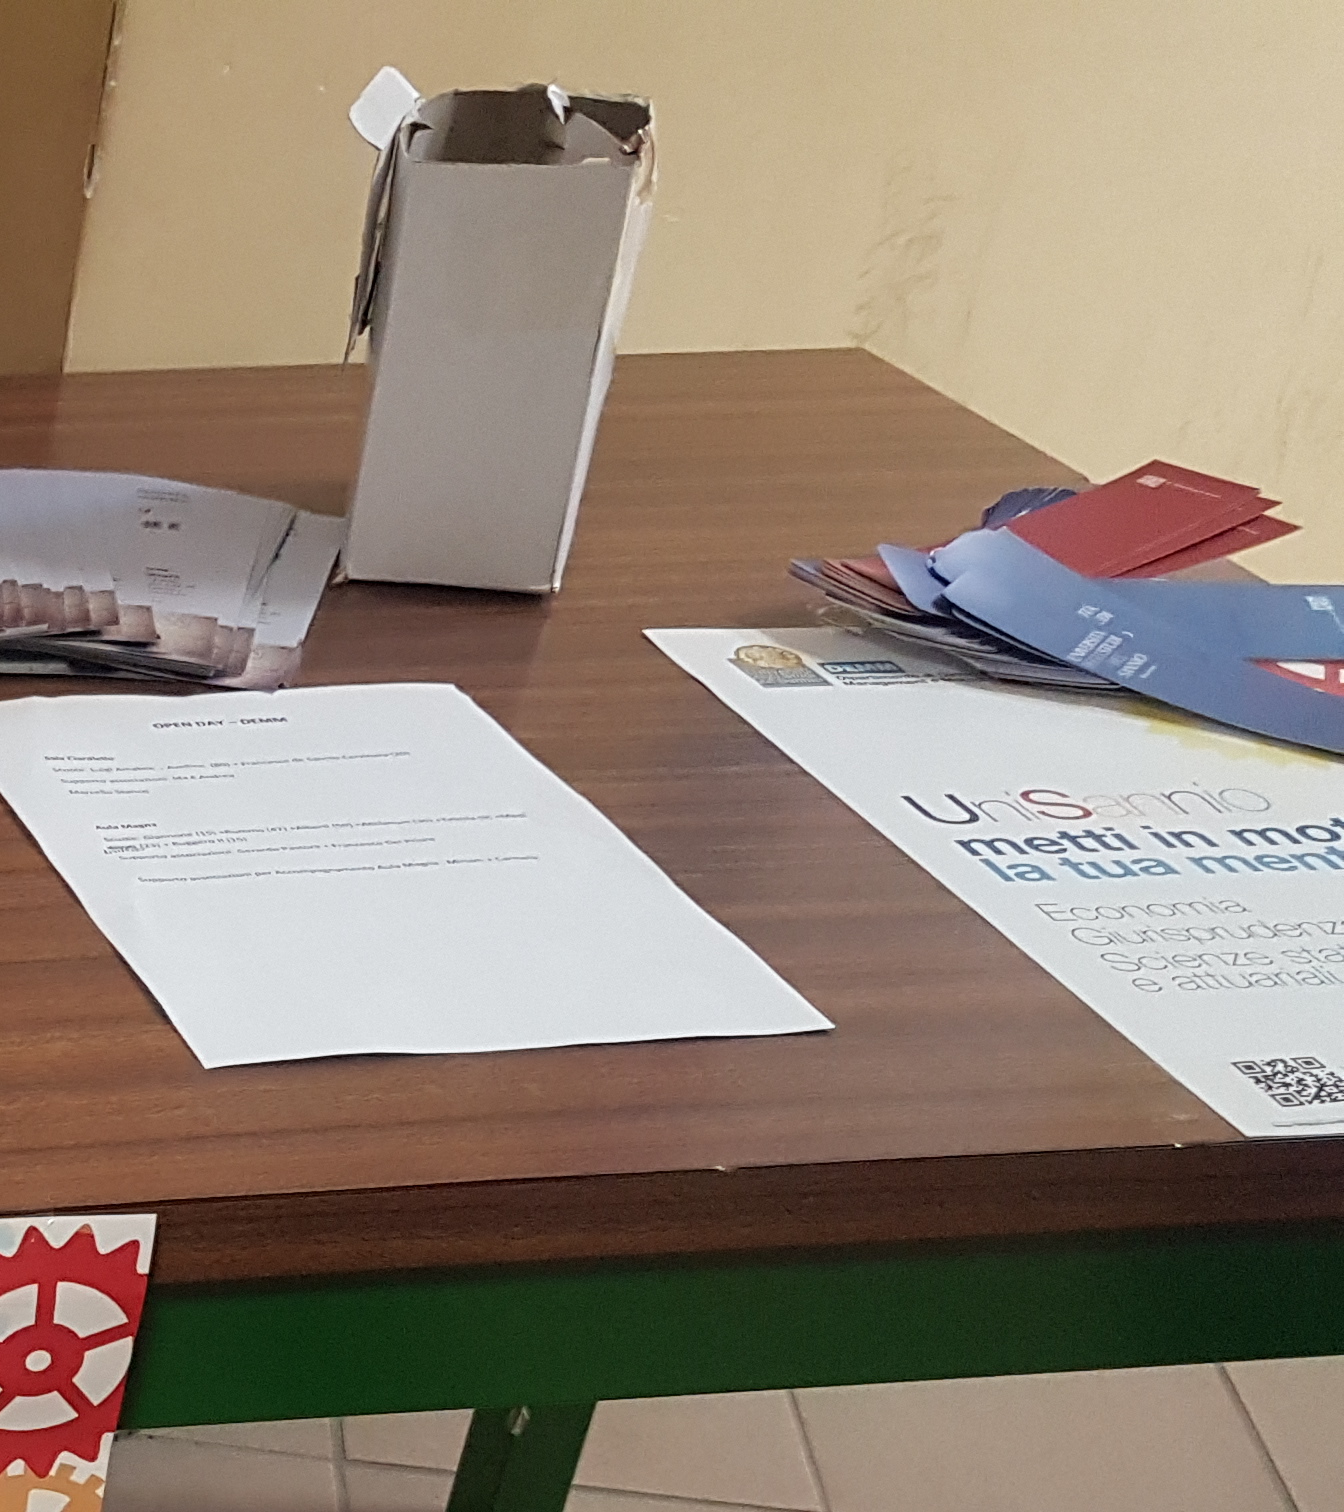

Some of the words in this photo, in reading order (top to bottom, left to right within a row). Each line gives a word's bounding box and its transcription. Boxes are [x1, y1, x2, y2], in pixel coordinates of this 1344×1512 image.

[823, 661, 901, 673] DEMM
[151, 720, 193, 730] OPEN
[194, 718, 226, 728] DAY
[240, 715, 289, 725] DEMM
[900, 781, 1272, 826] UniSannio
[953, 826, 1141, 858] metti
[1140, 825, 1220, 850] in
[978, 857, 1057, 883] la
[1058, 854, 1182, 881] tua
[1034, 897, 1250, 923] Economia
[1099, 949, 1275, 973] Scienze
[1131, 976, 1164, 993] e
[1170, 966, 1344, 993] attuariali
